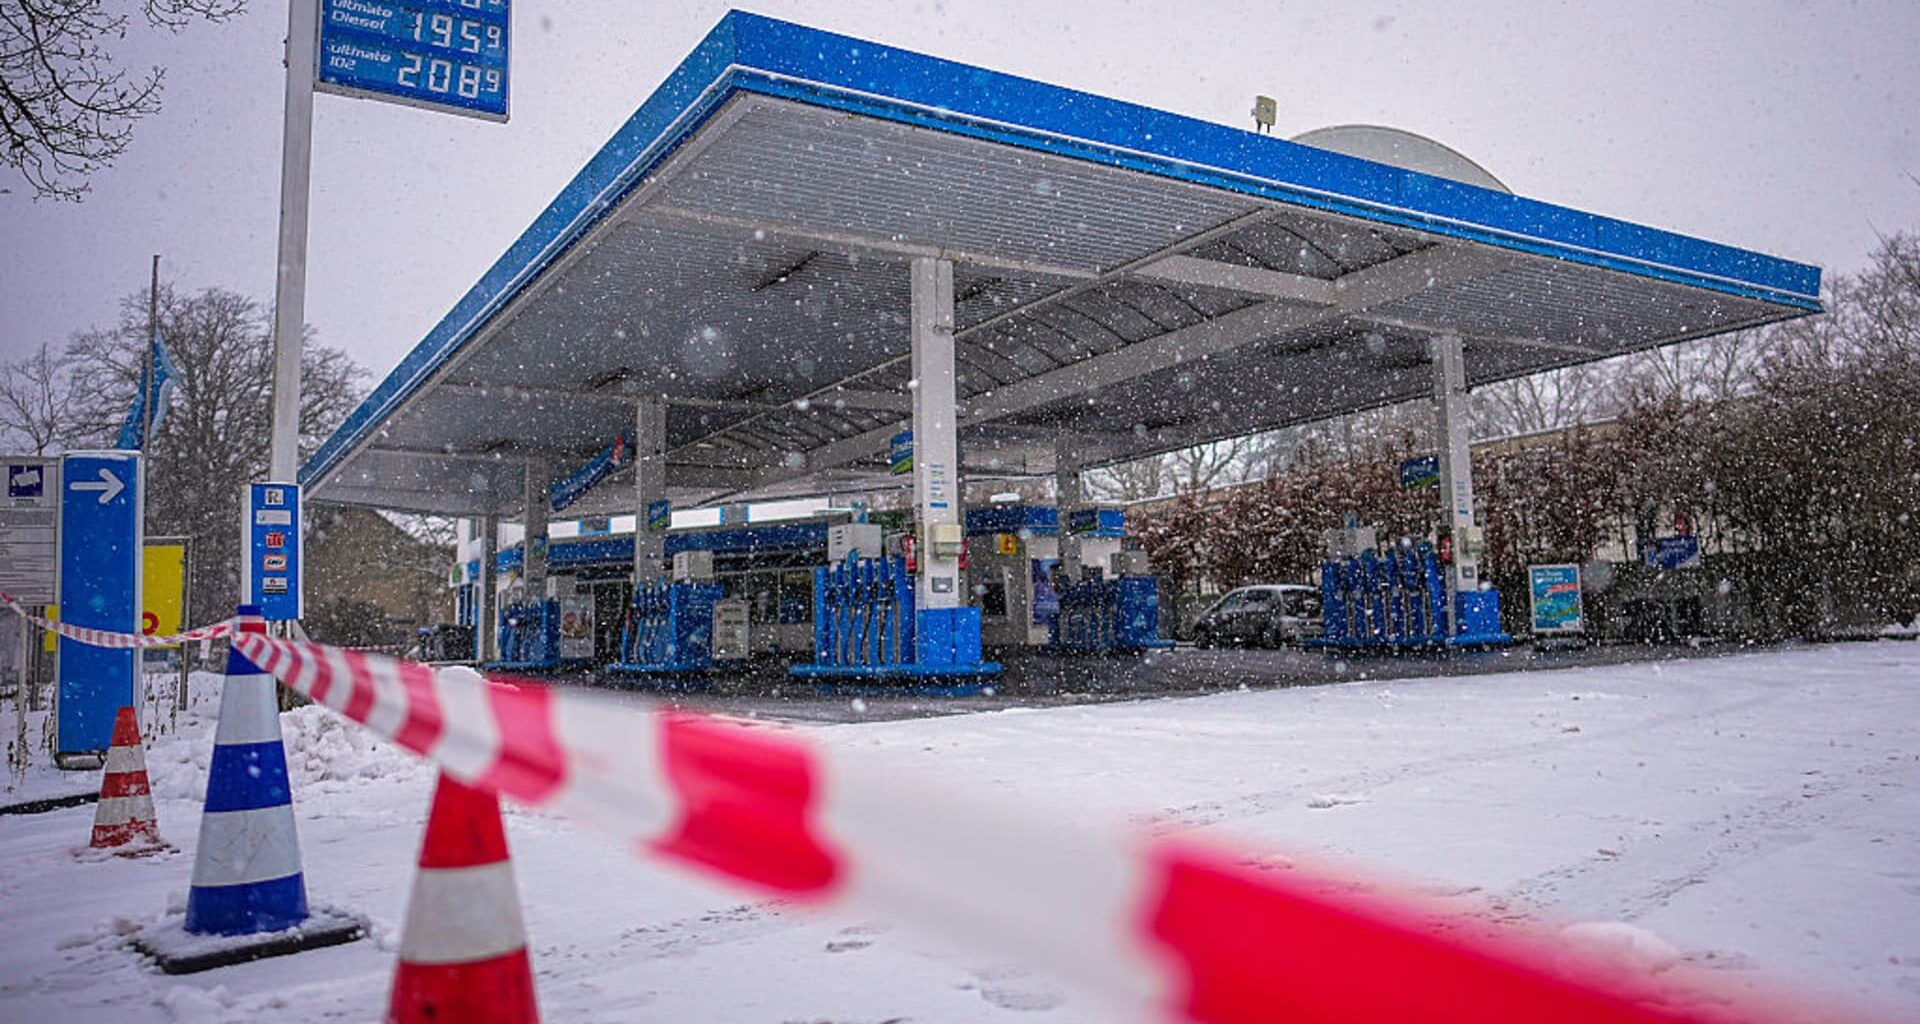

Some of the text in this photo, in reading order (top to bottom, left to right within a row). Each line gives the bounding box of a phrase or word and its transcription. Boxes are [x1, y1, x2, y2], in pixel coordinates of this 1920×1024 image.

[331, 10, 386, 29] Diesel
[330, 44, 392, 63] ultimate
[329, 56, 357, 71] 102
